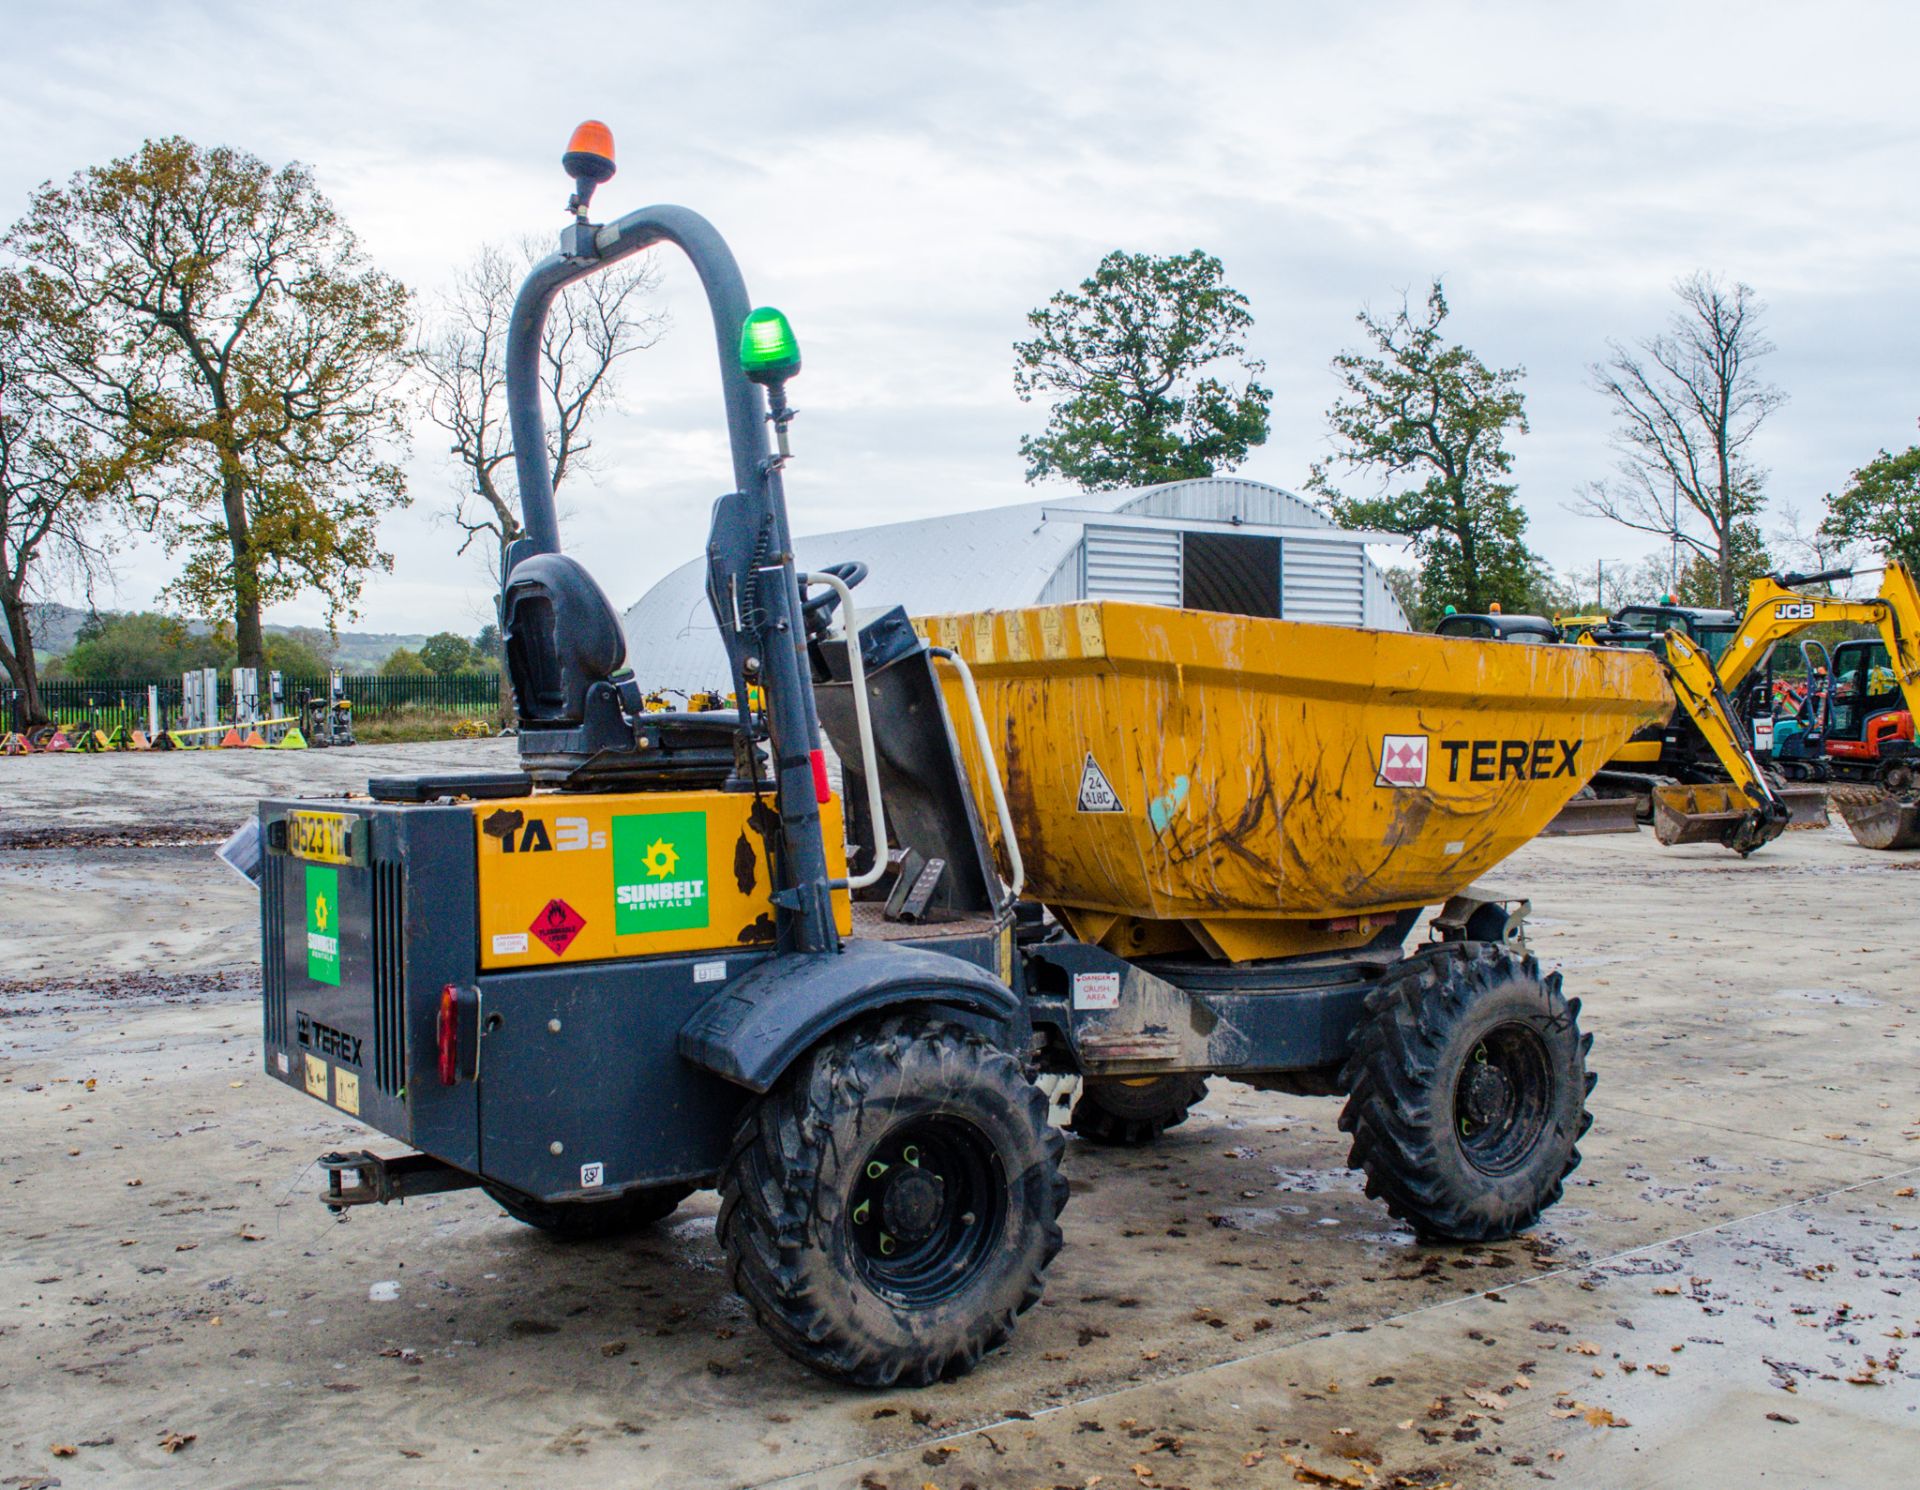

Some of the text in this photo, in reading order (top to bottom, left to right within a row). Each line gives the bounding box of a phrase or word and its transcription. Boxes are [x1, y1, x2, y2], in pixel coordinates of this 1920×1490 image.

[1775, 604, 1814, 618] JCB
[1441, 739, 1582, 782] TEREX
[1088, 777, 1102, 789] 24
[617, 880, 704, 904] SUNBELT
[629, 899, 692, 911] RENTALS
[312, 1021, 363, 1068] TEREX
